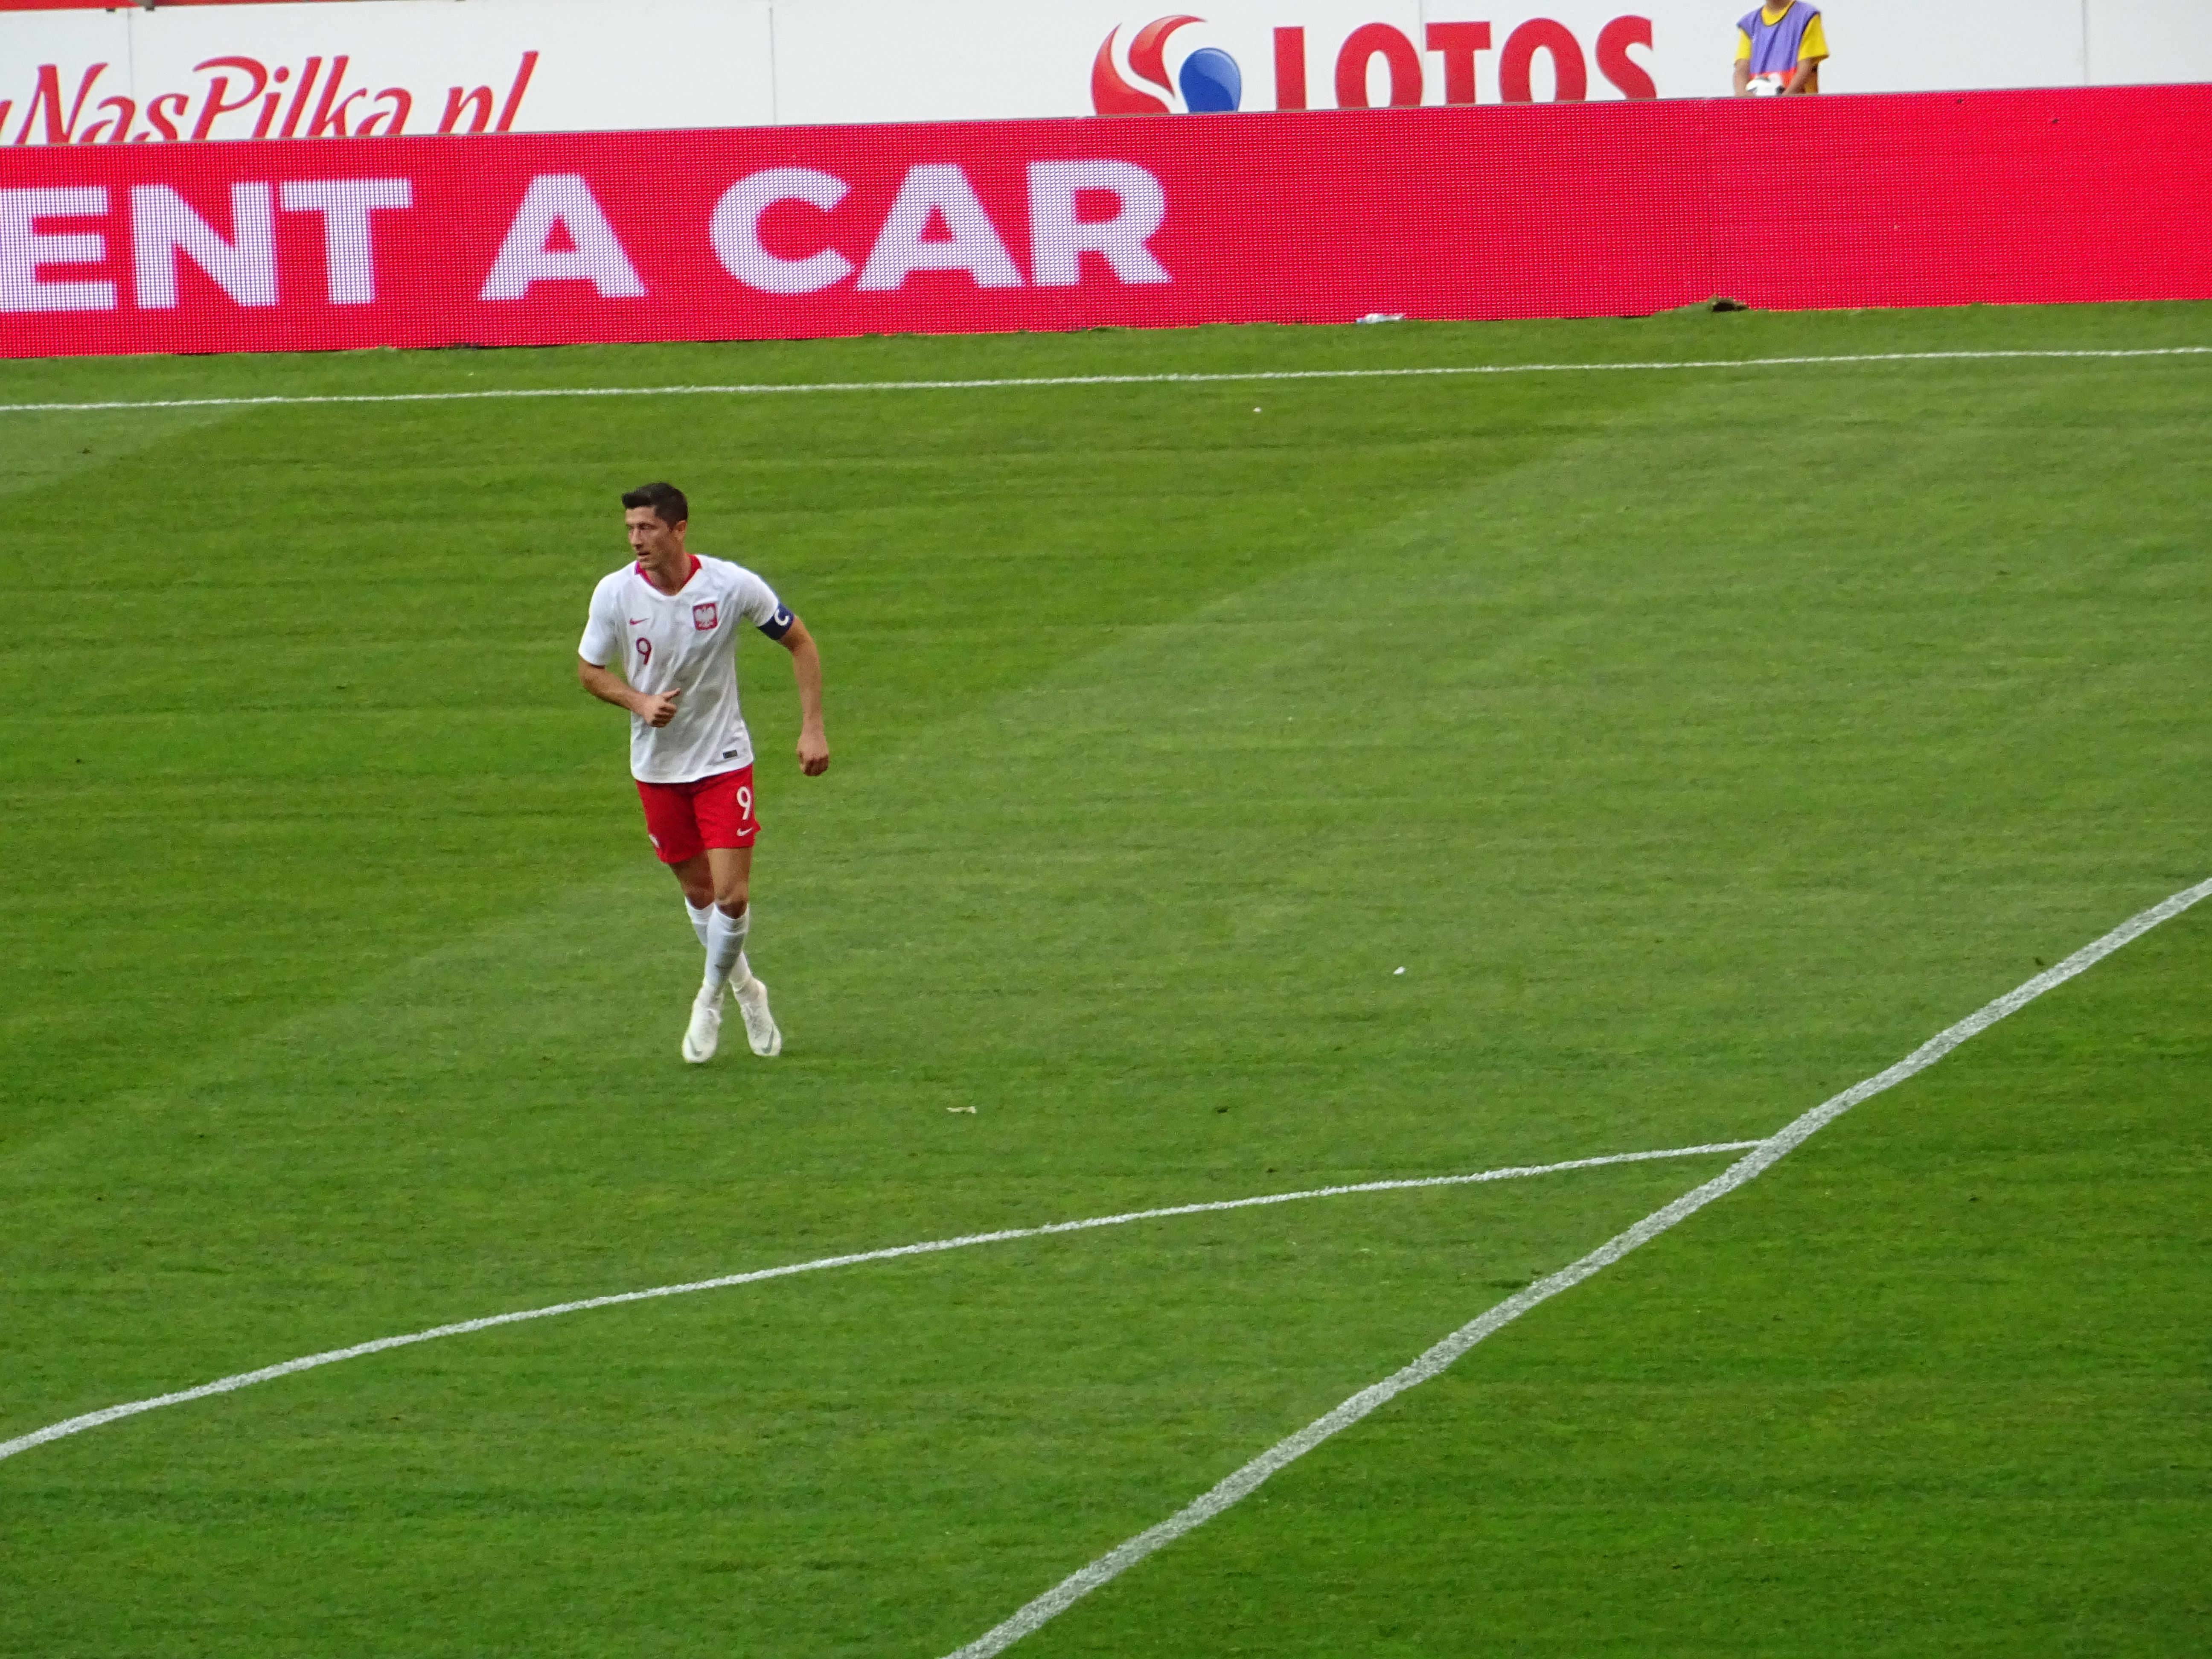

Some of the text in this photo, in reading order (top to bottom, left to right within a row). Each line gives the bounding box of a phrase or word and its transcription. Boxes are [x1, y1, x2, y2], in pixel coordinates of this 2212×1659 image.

[479, 173, 649, 301] A
[708, 159, 1174, 295] CAR
[635, 637, 652, 665] 9
[736, 786, 751, 820] 9
